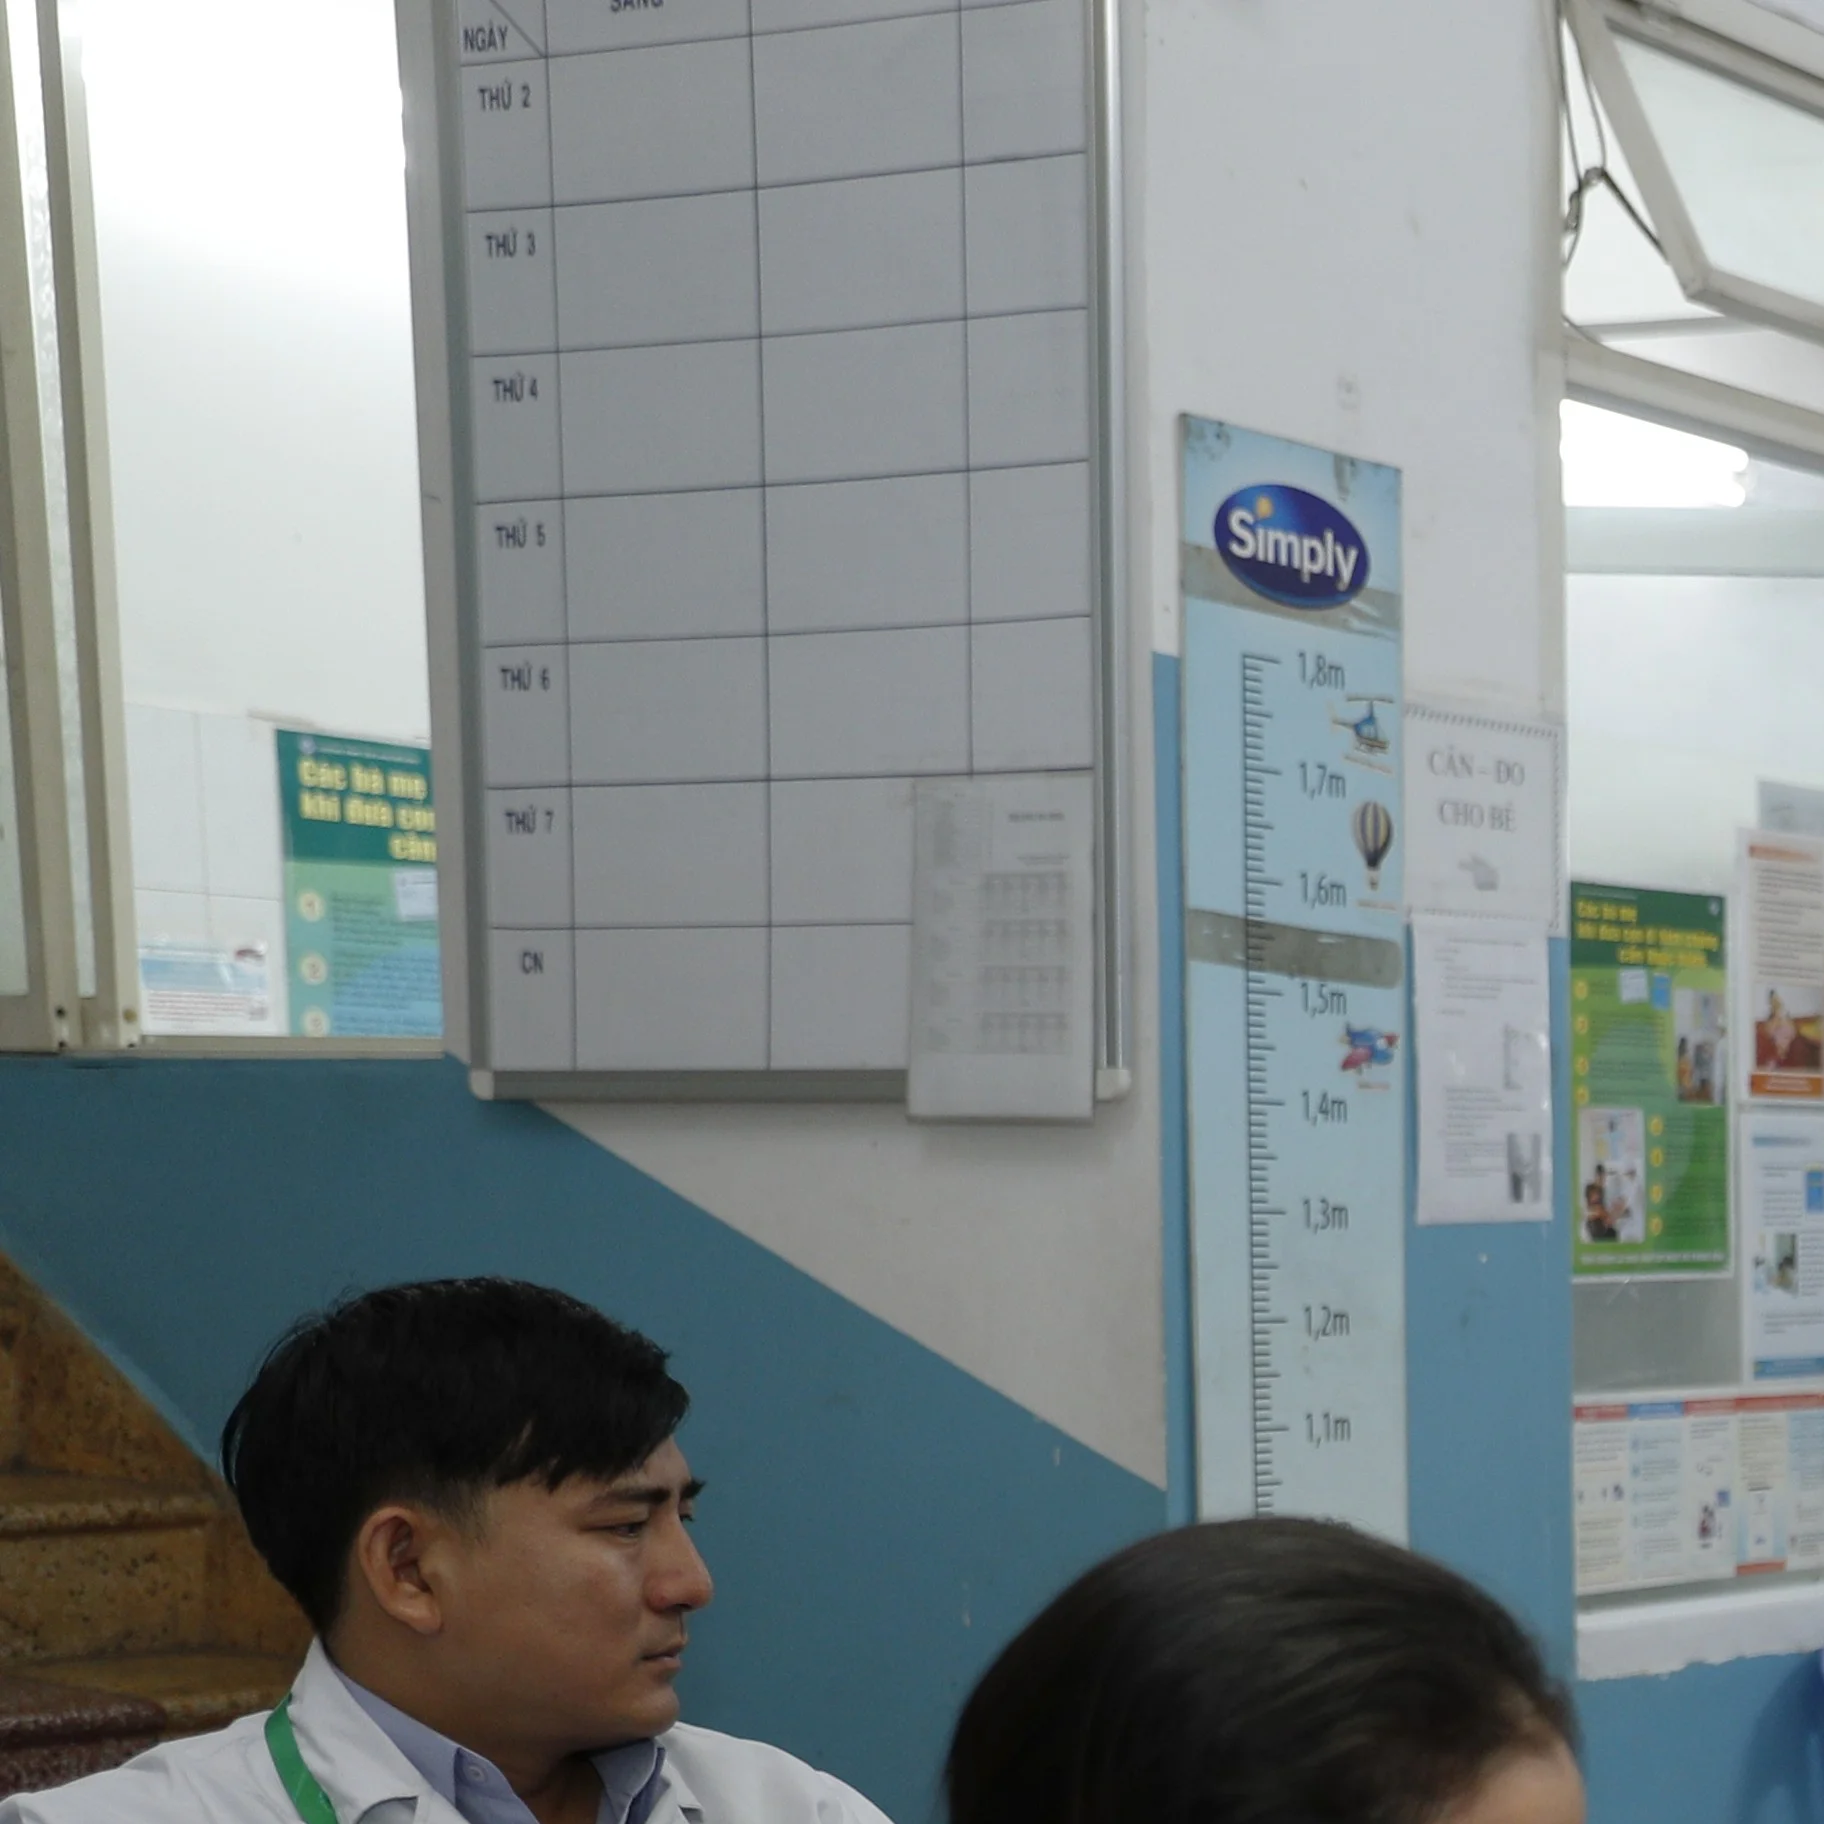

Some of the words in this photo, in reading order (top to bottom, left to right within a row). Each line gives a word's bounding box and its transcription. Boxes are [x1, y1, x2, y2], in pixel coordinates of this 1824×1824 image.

[463, 21, 508, 51] NGÀY
[521, 86, 531, 108] 2
[527, 232, 536, 256] 3
[529, 377, 539, 400] 4
[536, 522, 545, 547] 5
[1228, 497, 1358, 592] Simply
[540, 669, 550, 690] 6
[1298, 651, 1346, 690] 1,8m
[1299, 762, 1347, 799] 1,7m
[545, 811, 554, 834] 7
[1438, 800, 1486, 828] CHO
[1299, 872, 1347, 908] 1,6m
[1301, 982, 1347, 1018] 1,5m
[1302, 1090, 1348, 1125] 1,4m
[1302, 1198, 1349, 1233] 1,3m
[1304, 1306, 1350, 1340] 1,2m
[1305, 1412, 1351, 1446] 1,1m
